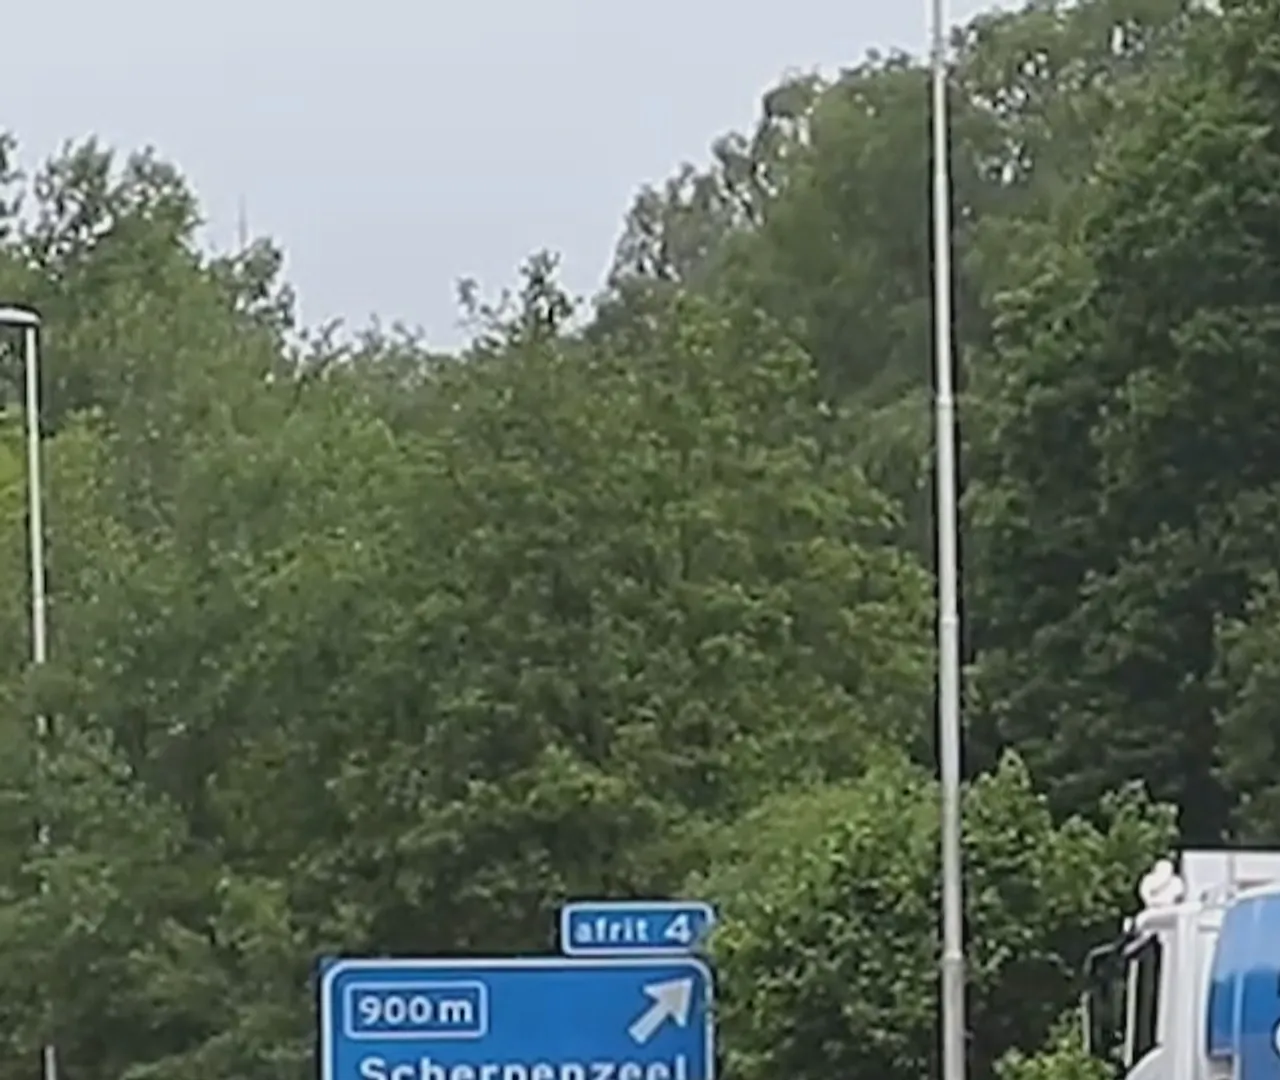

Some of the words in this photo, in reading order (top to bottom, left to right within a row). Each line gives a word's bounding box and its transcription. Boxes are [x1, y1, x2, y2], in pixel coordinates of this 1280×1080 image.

[574, 915, 649, 943] afrit
[664, 913, 691, 944] 4
[358, 995, 431, 1025] 900
[439, 1000, 473, 1024] m
